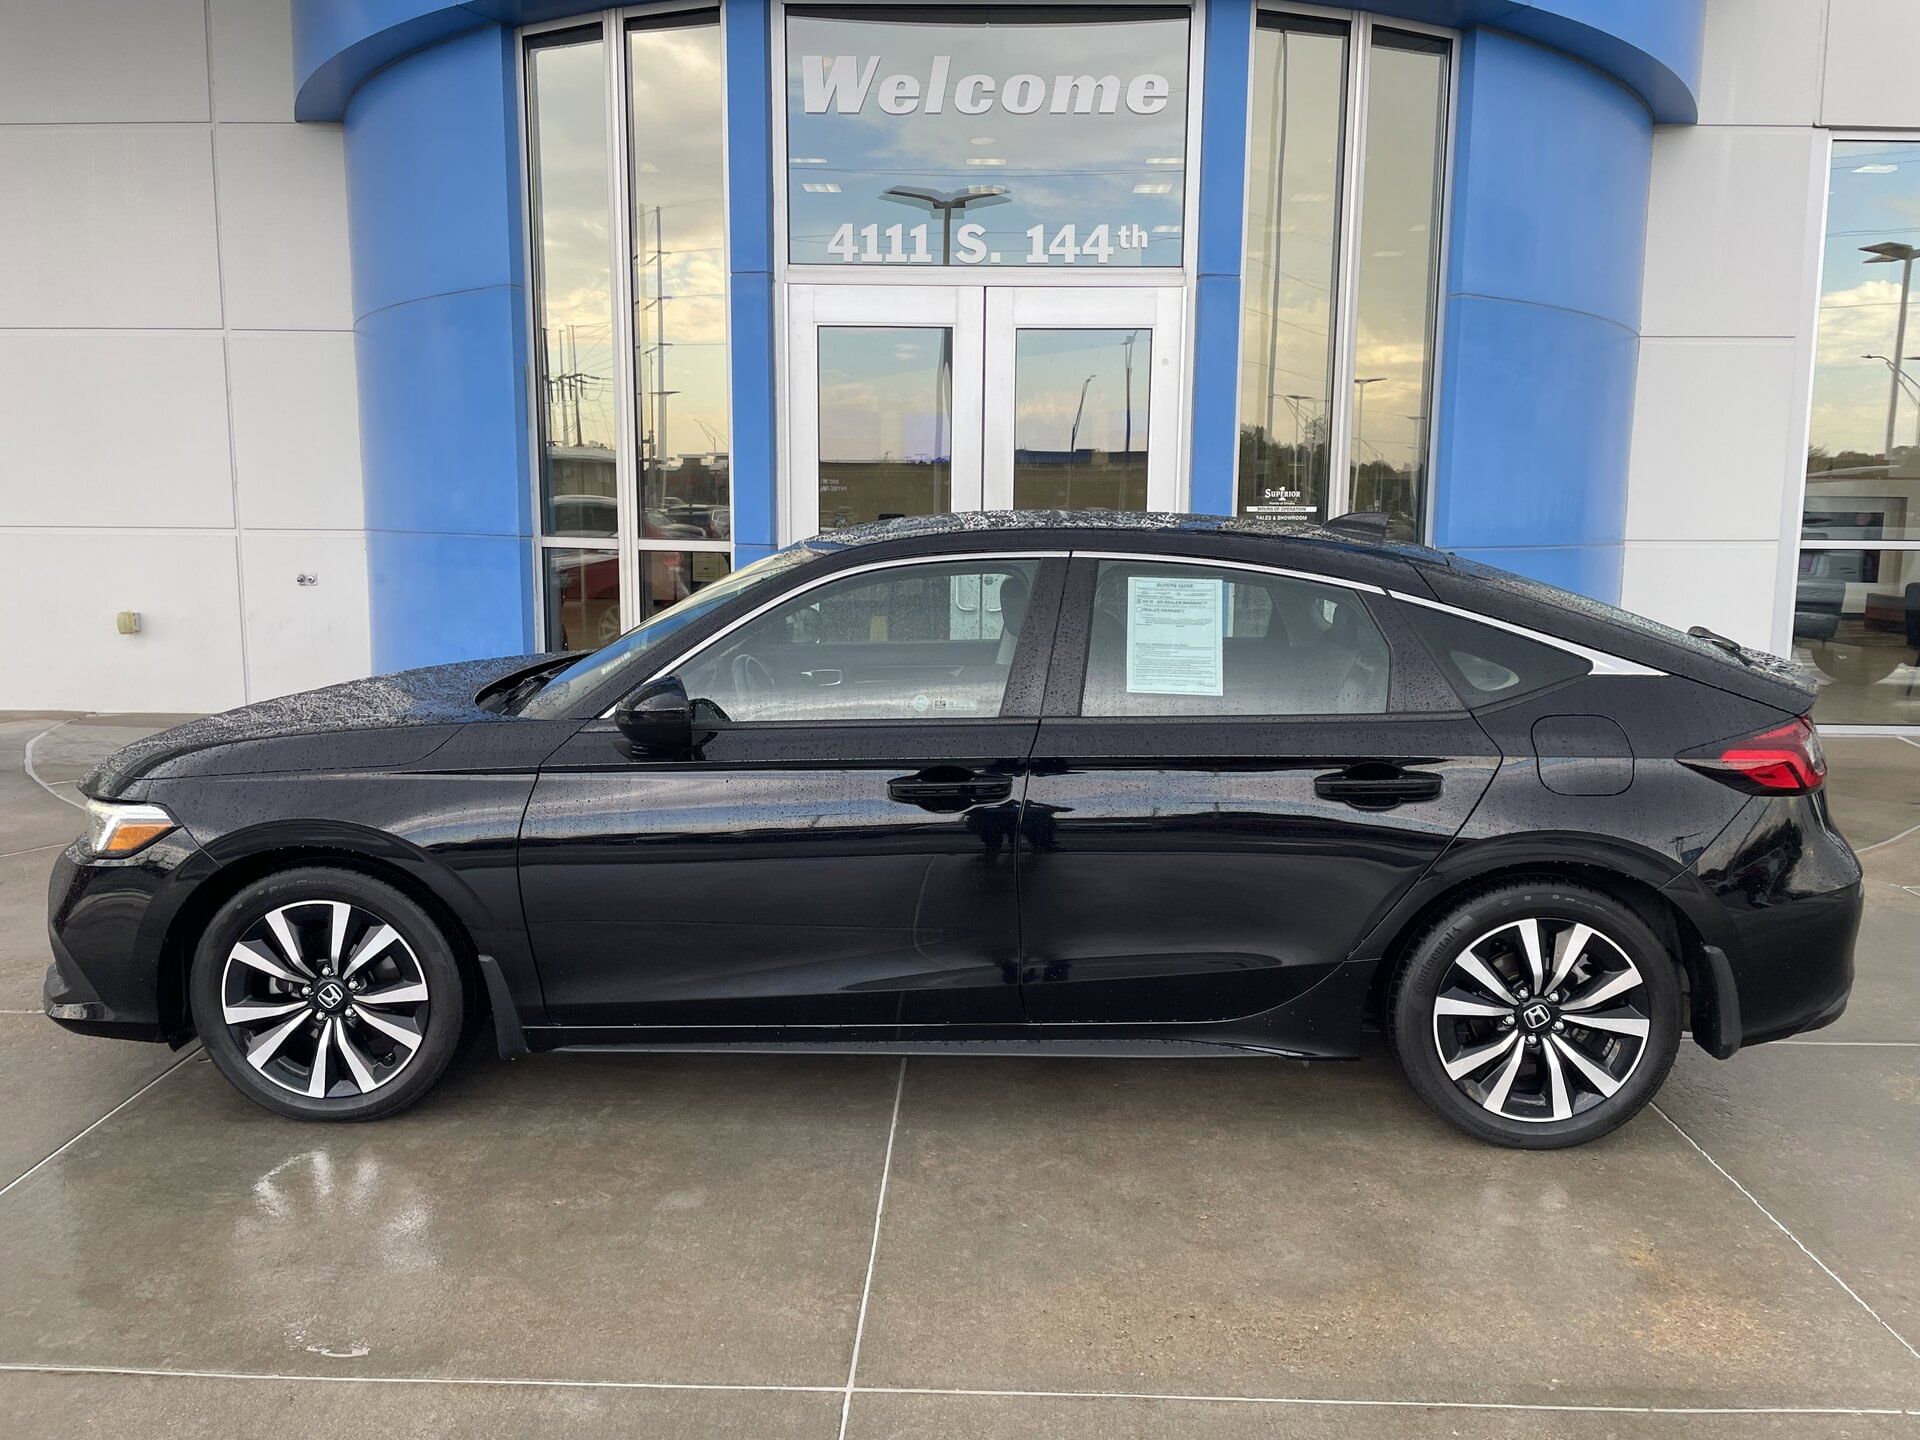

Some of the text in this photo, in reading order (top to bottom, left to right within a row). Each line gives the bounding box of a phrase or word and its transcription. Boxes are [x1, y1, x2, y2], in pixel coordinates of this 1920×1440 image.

[802, 55, 1169, 115] Welcome
[827, 223, 1148, 264] 4111 S. 144th
